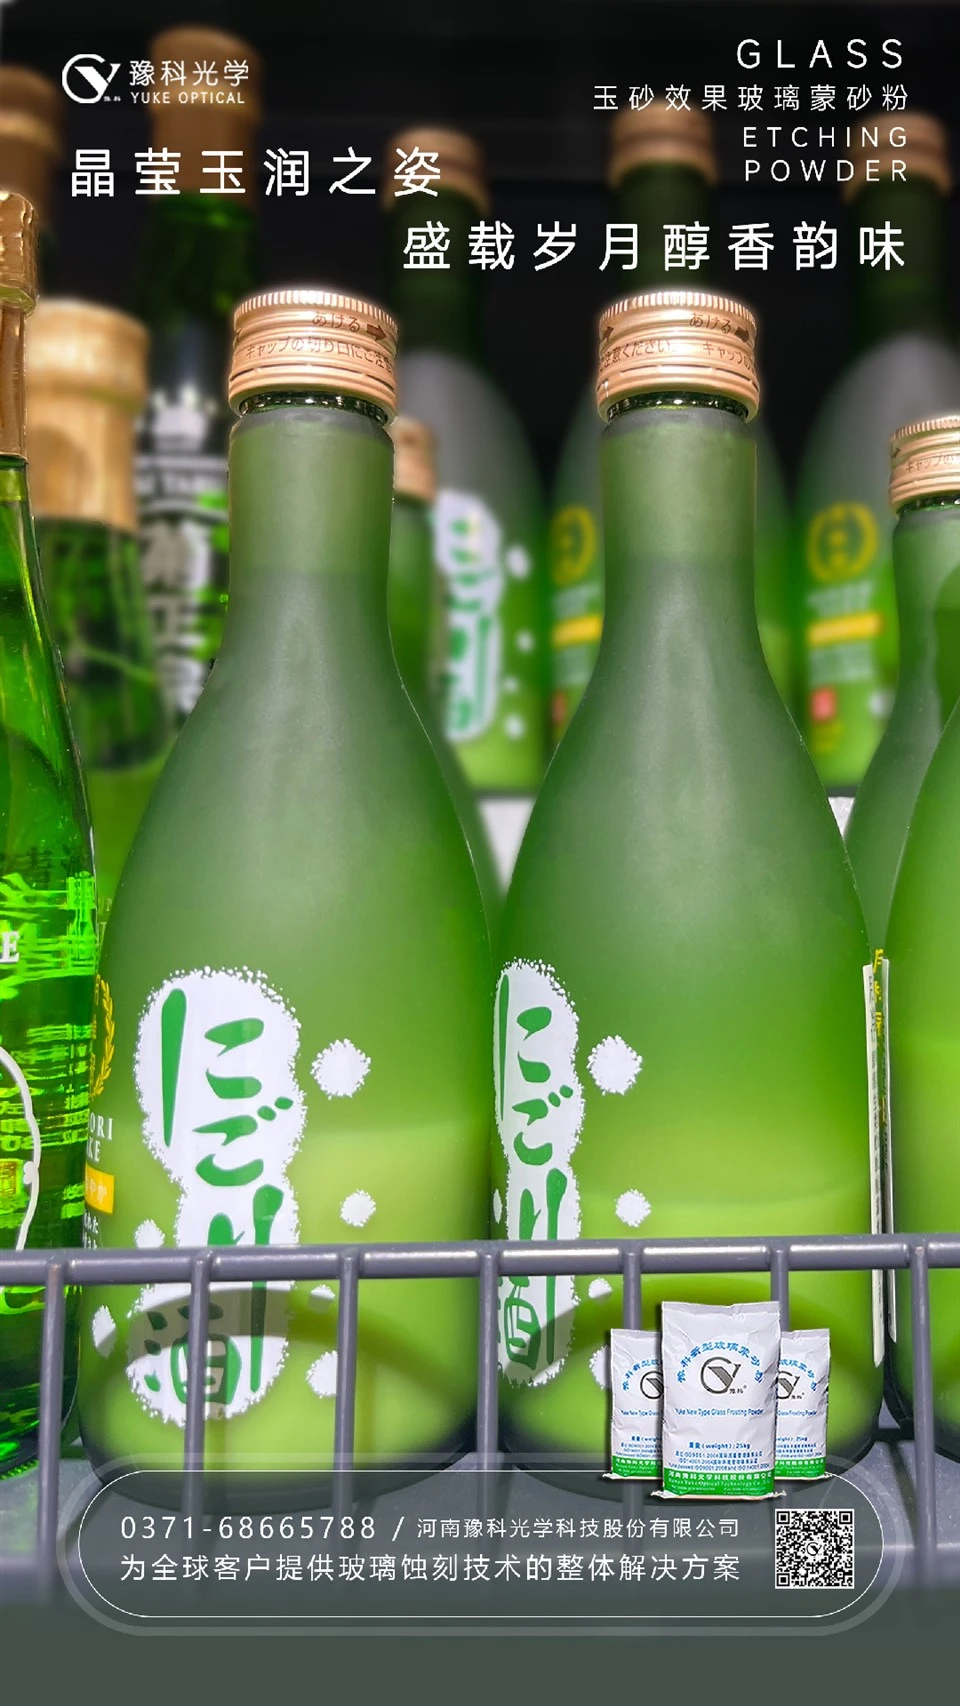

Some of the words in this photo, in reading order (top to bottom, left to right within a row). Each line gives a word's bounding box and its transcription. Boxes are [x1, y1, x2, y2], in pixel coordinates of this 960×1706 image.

[312, 311, 361, 333] あける
[689, 312, 731, 334] あける
[88, 1111, 113, 1141] ORI
